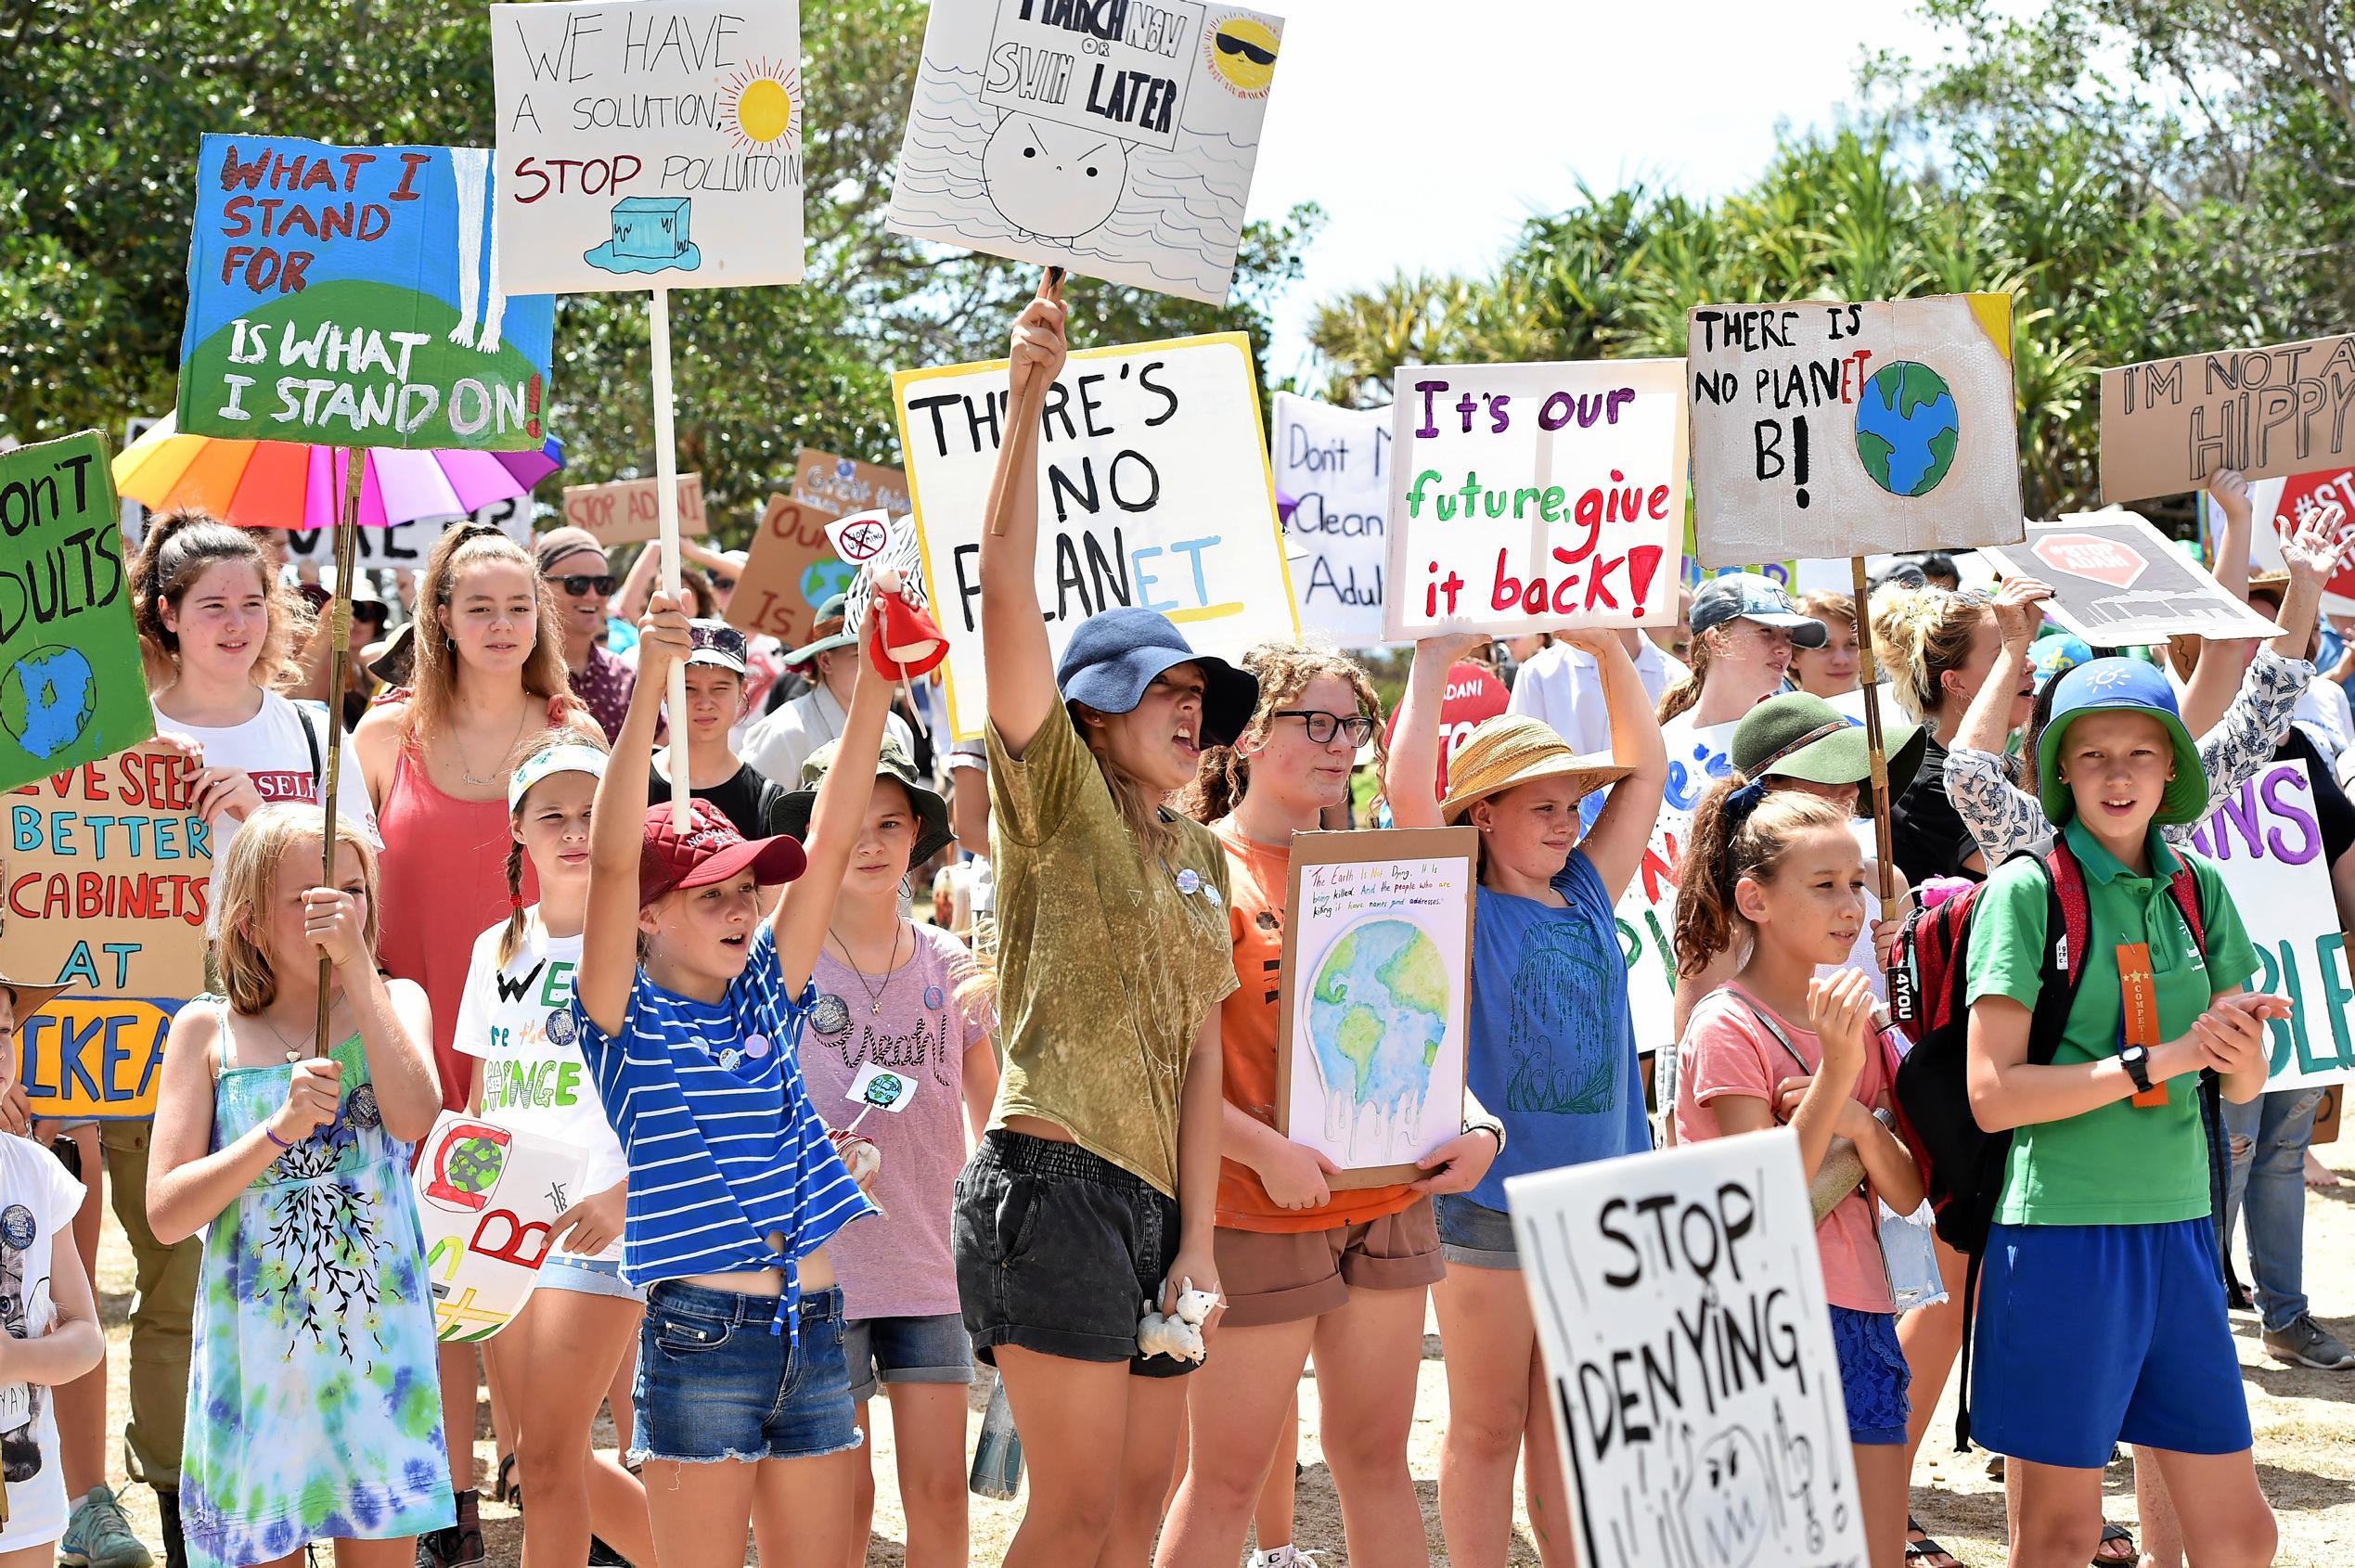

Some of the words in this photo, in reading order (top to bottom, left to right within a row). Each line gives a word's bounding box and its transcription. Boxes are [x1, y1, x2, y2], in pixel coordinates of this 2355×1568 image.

[516, 12, 603, 84] WE
[624, 11, 744, 74] HAVE
[1081, 38, 1110, 57] OR
[512, 93, 542, 134] A
[573, 92, 722, 131] SOLUTION,
[986, 42, 1075, 105] SWIM
[1086, 63, 1177, 134] LATER
[220, 145, 376, 193] WHAT
[389, 153, 431, 200] I
[514, 154, 642, 203] STOP
[220, 196, 391, 242] STAND
[220, 247, 315, 293] FOR
[227, 318, 272, 365] IS
[279, 318, 431, 384] WHAT
[1695, 309, 1799, 353] THERE
[1826, 303, 1862, 340] IS
[218, 374, 256, 420] I
[270, 378, 439, 434] STAND
[447, 372, 542, 439] ON!
[1695, 368, 1739, 405] NO
[1756, 350, 1872, 408] PLANET
[2124, 362, 2182, 415] I'M
[2206, 346, 2311, 394] NOT
[907, 362, 1178, 456] THRE'S
[1414, 380, 1511, 439] It's
[1538, 387, 1636, 431] our
[2190, 371, 2355, 482] HIPPY
[1048, 448, 1160, 523] NO
[1754, 415, 1810, 508] B!
[568, 494, 616, 528] STOP
[628, 483, 700, 523] ADNI
[1293, 492, 1383, 537] Clean
[0, 523, 121, 646] DULTS
[953, 526, 1222, 632] PANET
[1306, 556, 1383, 608] Adul
[1424, 561, 1464, 618] it
[1490, 546, 1664, 619] back!
[750, 591, 795, 636] Is
[1444, 679, 1482, 700] DANI
[12, 805, 212, 860] BETTER
[9, 872, 211, 926] CABINETS
[1394, 881, 1415, 893] people
[1419, 880, 1433, 889] who
[53, 941, 142, 989] AT
[1897, 973, 1912, 1020] 4YOU
[1599, 1181, 1756, 1288] STOP
[1578, 1288, 1808, 1463] DENYING
